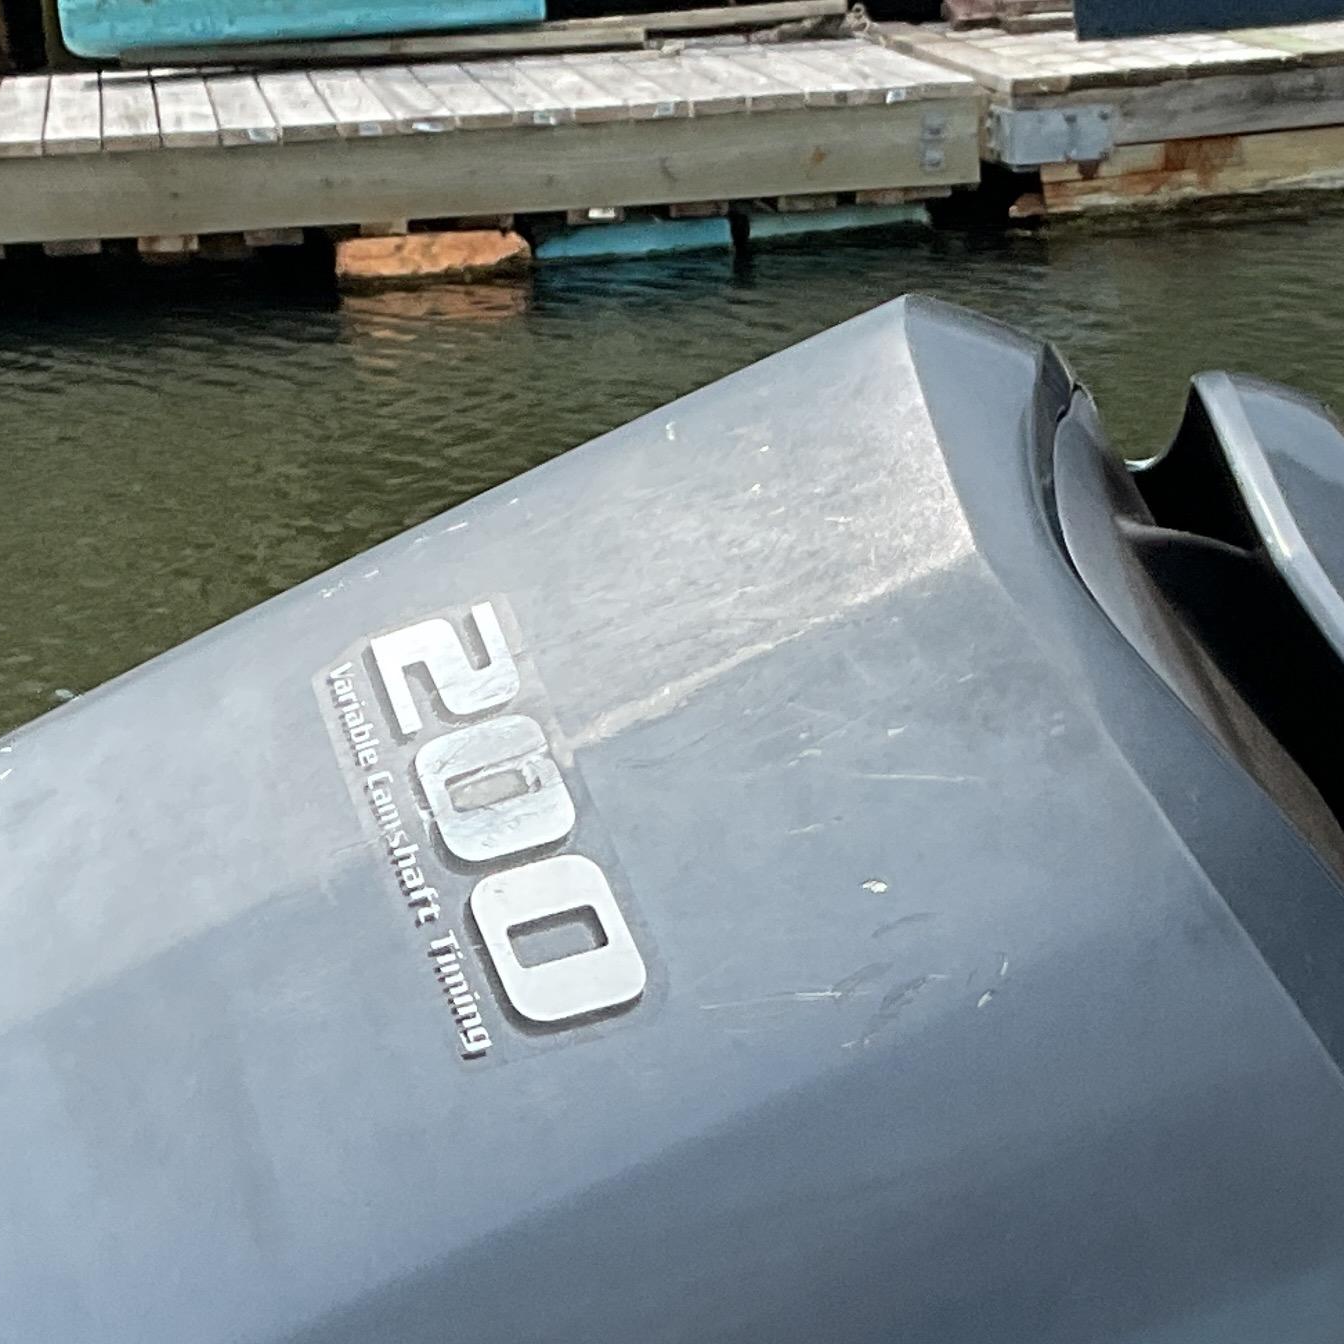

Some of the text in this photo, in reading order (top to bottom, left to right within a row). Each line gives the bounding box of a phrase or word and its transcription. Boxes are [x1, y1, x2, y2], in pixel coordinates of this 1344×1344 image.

[329, 661, 493, 1053] Variable Camshaft Timing
[369, 600, 647, 1022] 200
